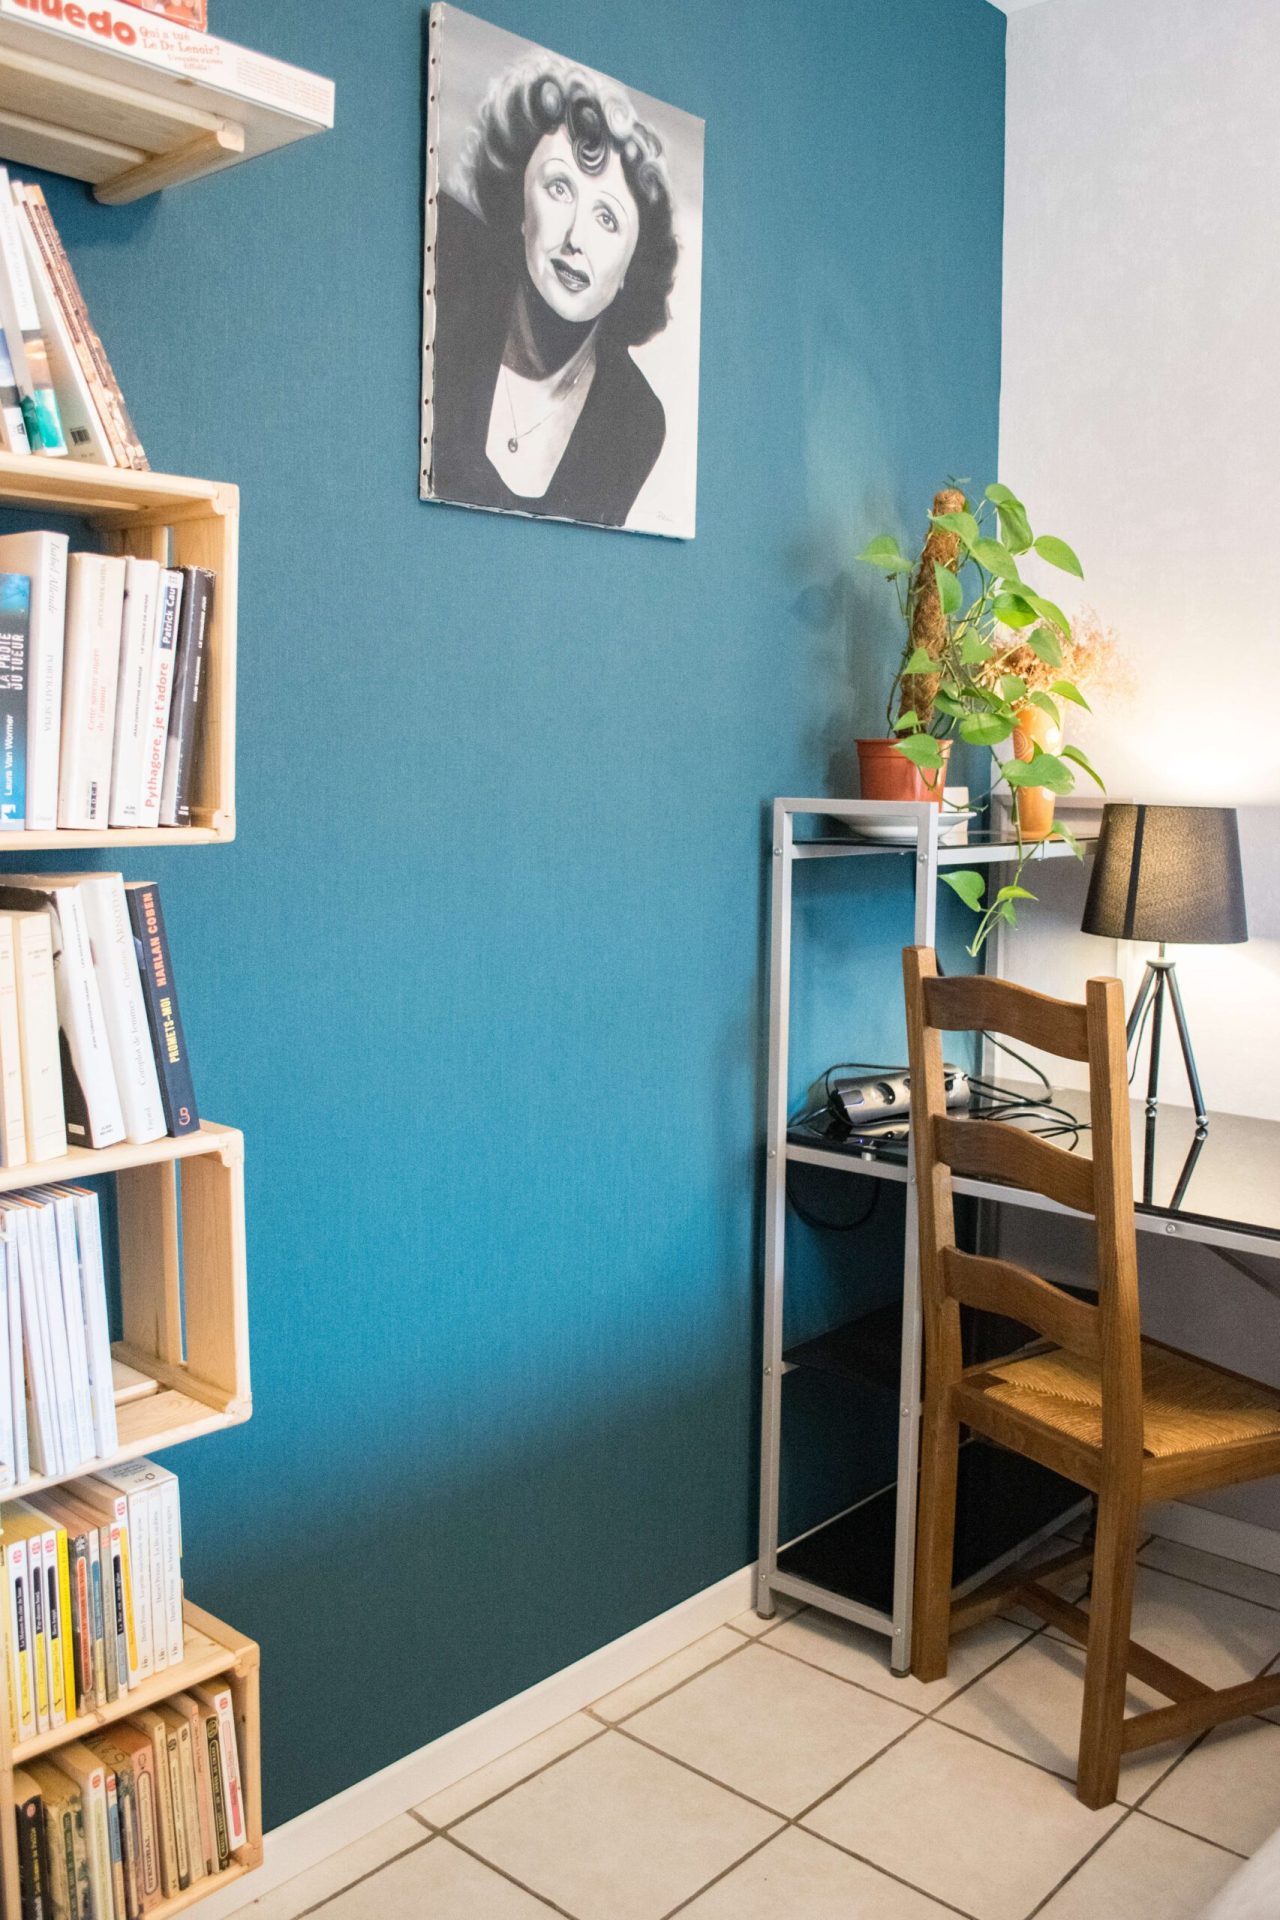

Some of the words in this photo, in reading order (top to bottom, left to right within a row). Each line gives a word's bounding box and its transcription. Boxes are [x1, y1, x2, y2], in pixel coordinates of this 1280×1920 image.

[12, 0, 137, 46] uedo
[162, 610, 174, 645] Patrick
[0, 632, 11, 669] PROIE
[11, 634, 25, 671] TUEUR
[0, 673, 11, 689] LA
[155, 662, 170, 711] t'adore
[4, 714, 14, 750] Wormer
[153, 716, 165, 730] je
[4, 752, 13, 768] Van
[144, 734, 162, 808] Pythagore,
[4, 770, 13, 796] Laura
[142, 892, 158, 935] COBEN
[150, 936, 167, 987] HARLAN
[159, 997, 180, 1064] PROMETS-MOI
